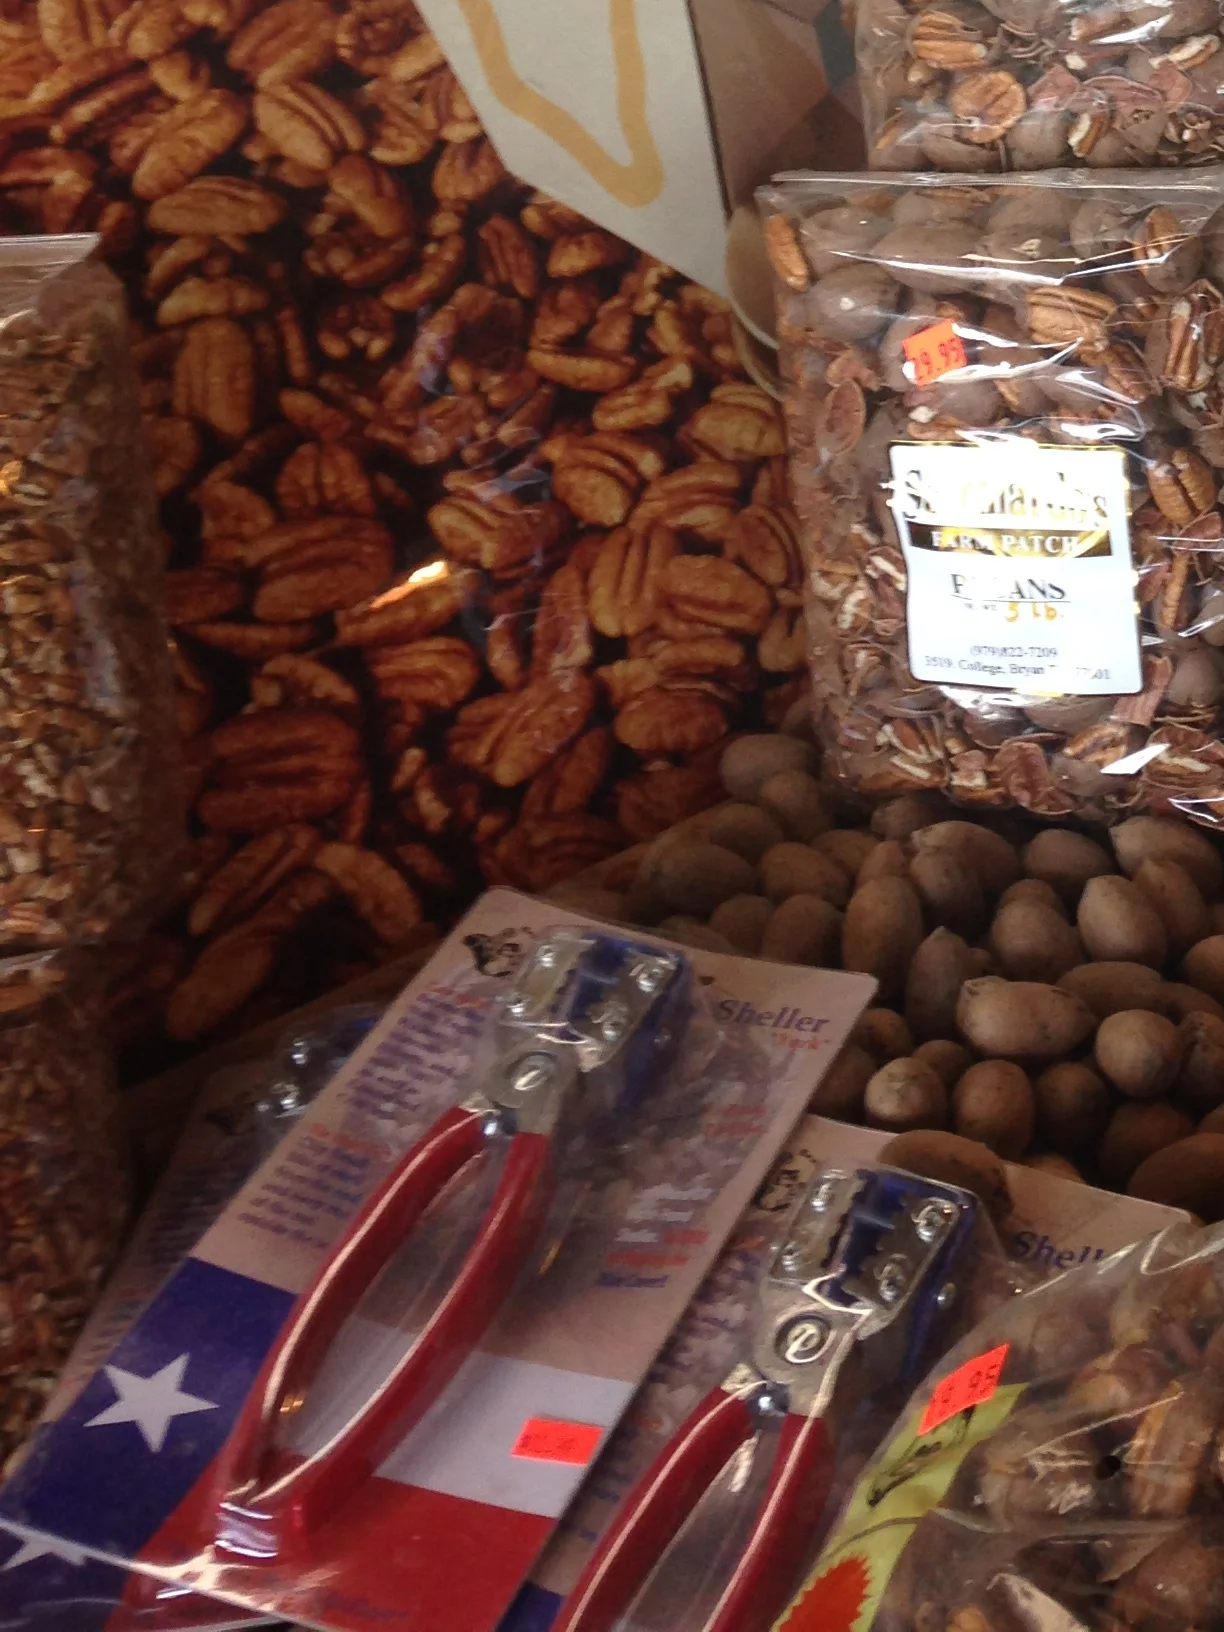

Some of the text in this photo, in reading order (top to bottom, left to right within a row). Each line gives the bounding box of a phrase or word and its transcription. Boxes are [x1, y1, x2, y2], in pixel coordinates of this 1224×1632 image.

[1000, 534, 1080, 555] PATCH
[950, 573, 1067, 600] PANS
[714, 999, 831, 1033] Sheller
